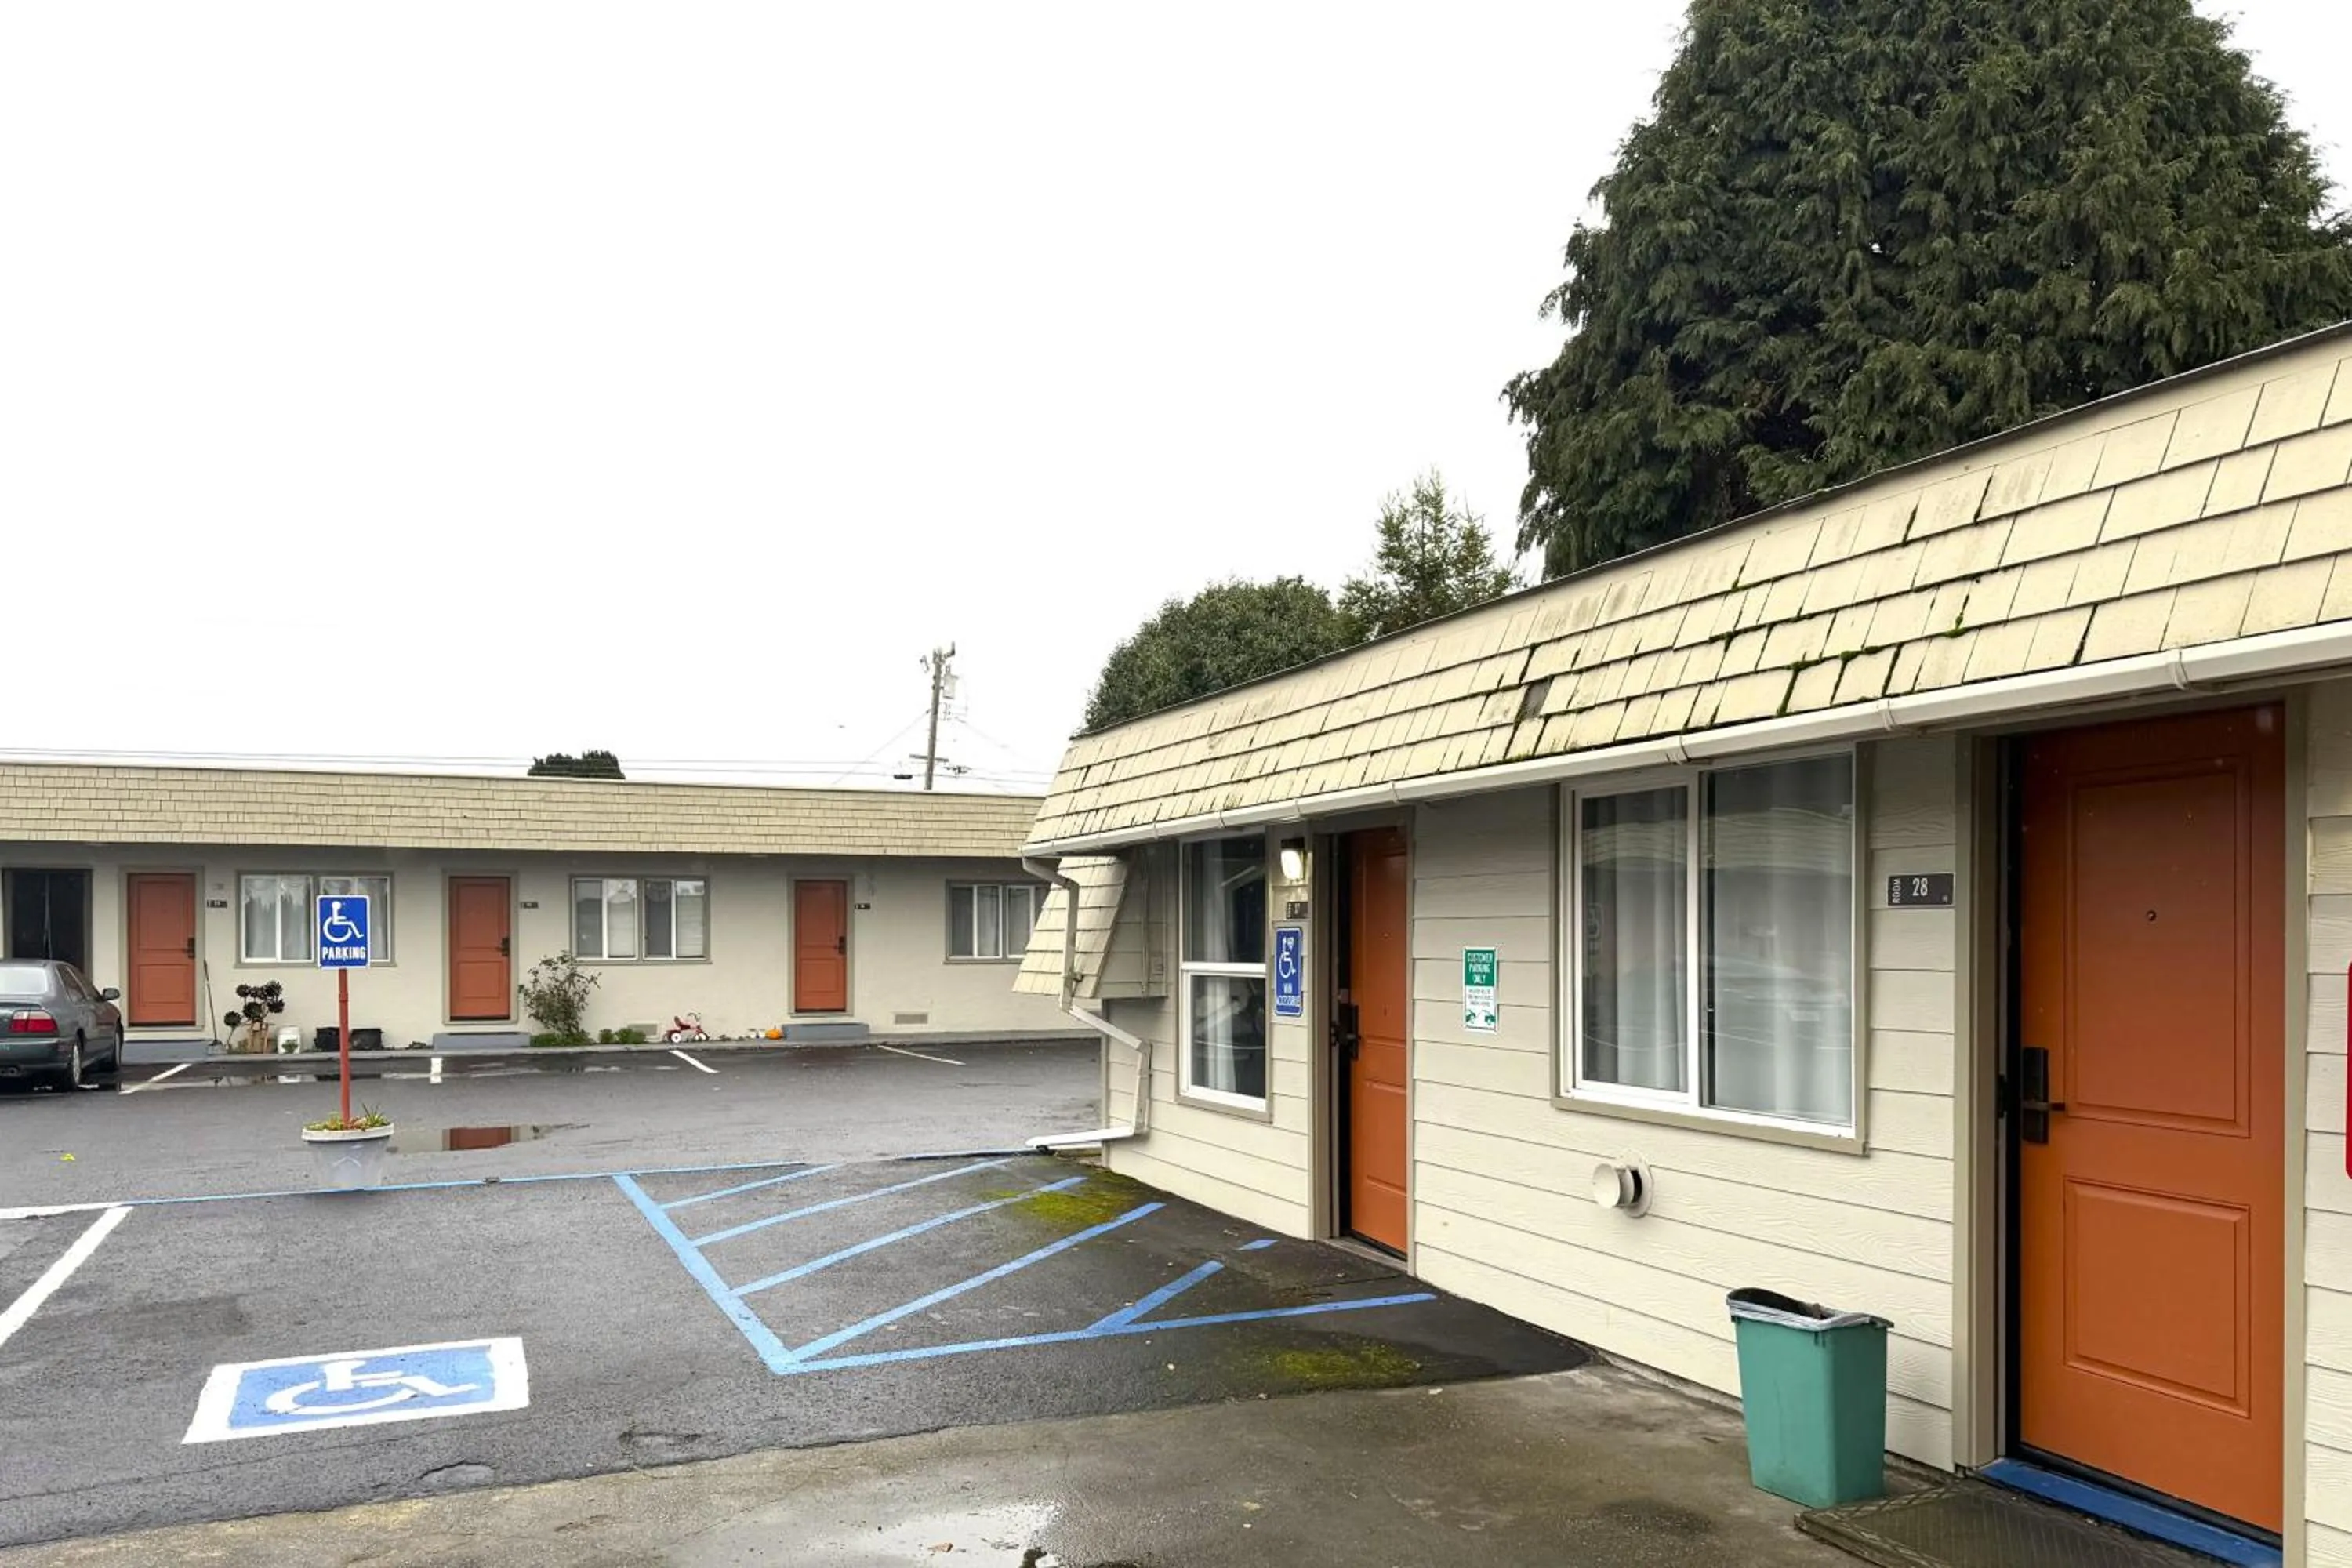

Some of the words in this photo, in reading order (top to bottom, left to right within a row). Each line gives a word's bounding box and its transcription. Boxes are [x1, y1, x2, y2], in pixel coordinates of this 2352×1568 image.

[1892, 878, 1901, 904] ROOM
[1912, 877, 1928, 897] 28
[322, 946, 366, 960] PARKING
